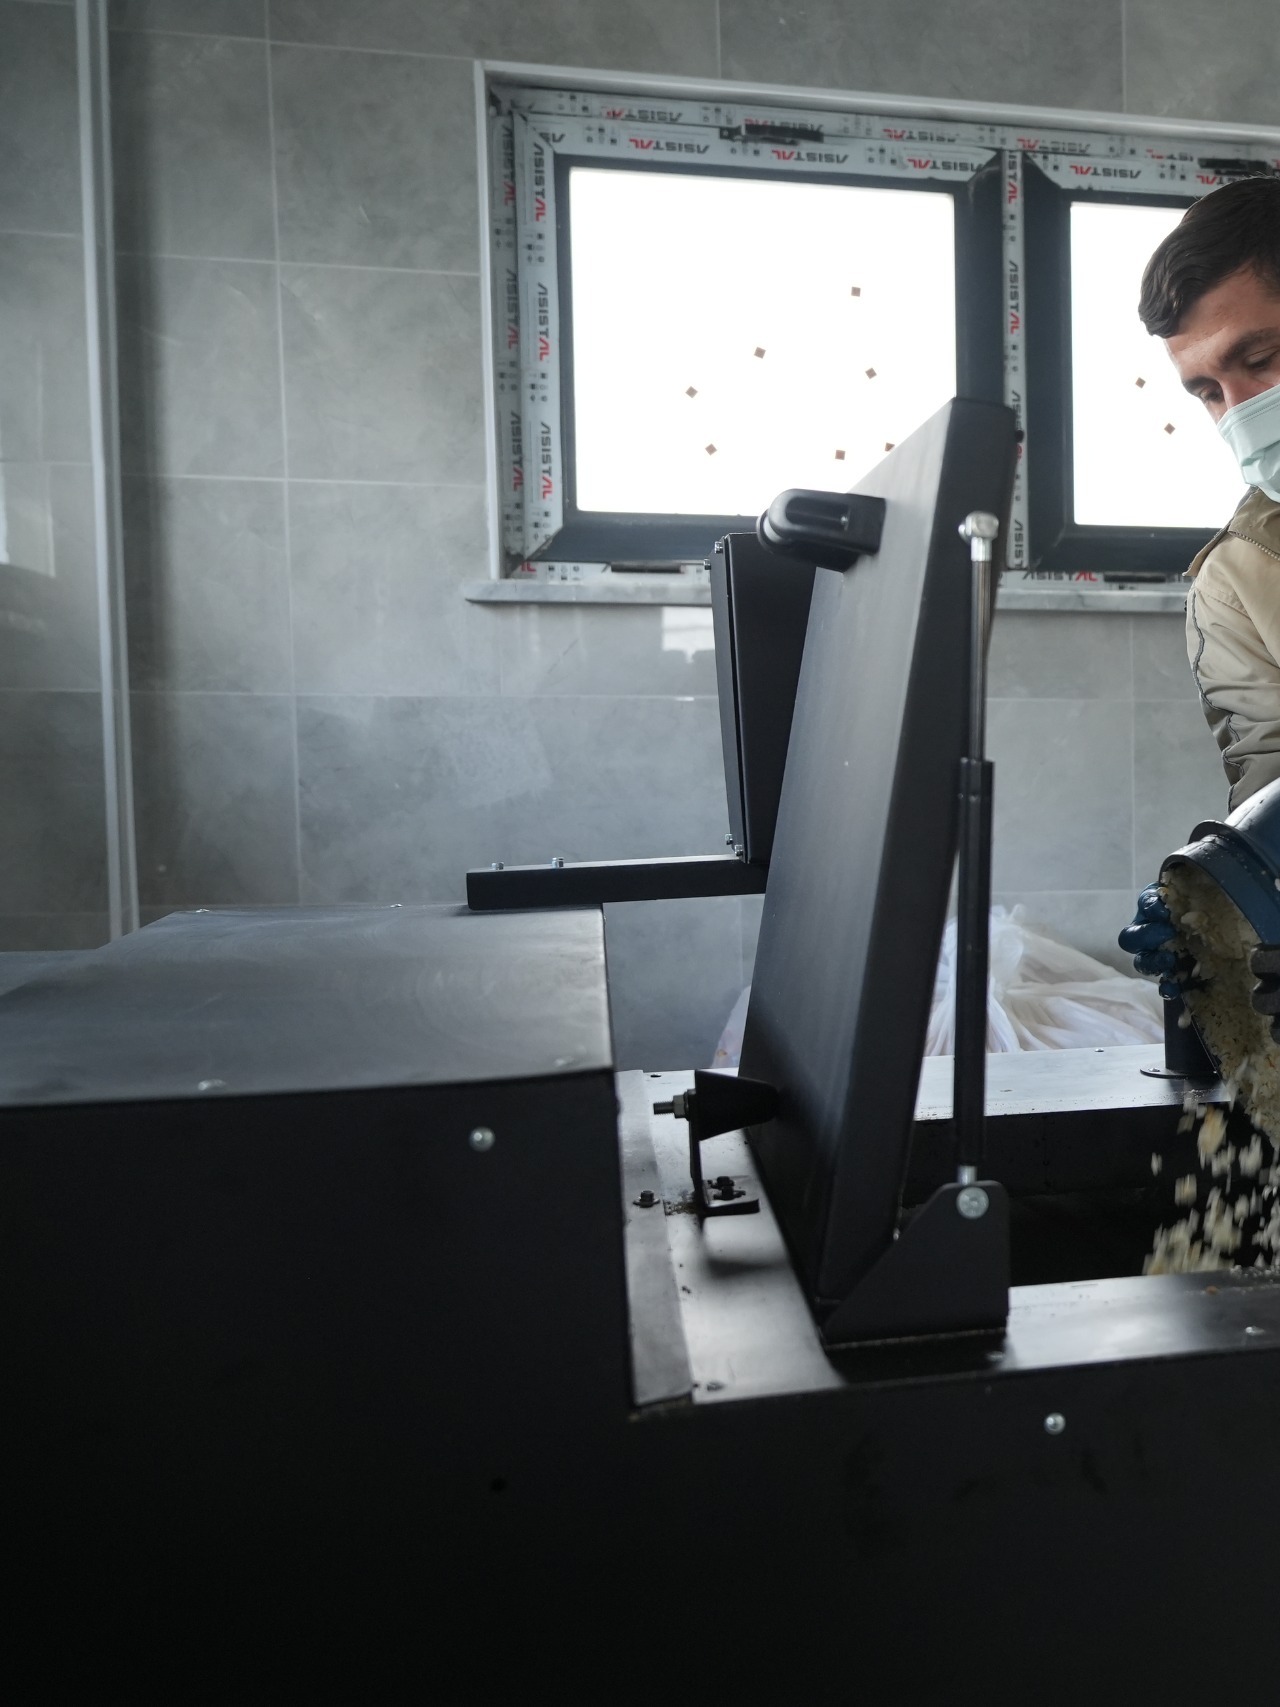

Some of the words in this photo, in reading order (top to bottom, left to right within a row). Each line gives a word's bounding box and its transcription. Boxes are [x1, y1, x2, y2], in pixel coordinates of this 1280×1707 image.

[629, 138, 710, 154] ASISTAL
[771, 149, 849, 164] ASISTAL
[1069, 164, 1142, 179] ASISTAL
[534, 141, 546, 222] ASISTAL
[1008, 153, 1018, 205] ISTAL
[538, 281, 550, 362] ASISTAL
[1009, 260, 1020, 335] ASISTAL
[541, 421, 553, 500] ASISTAL
